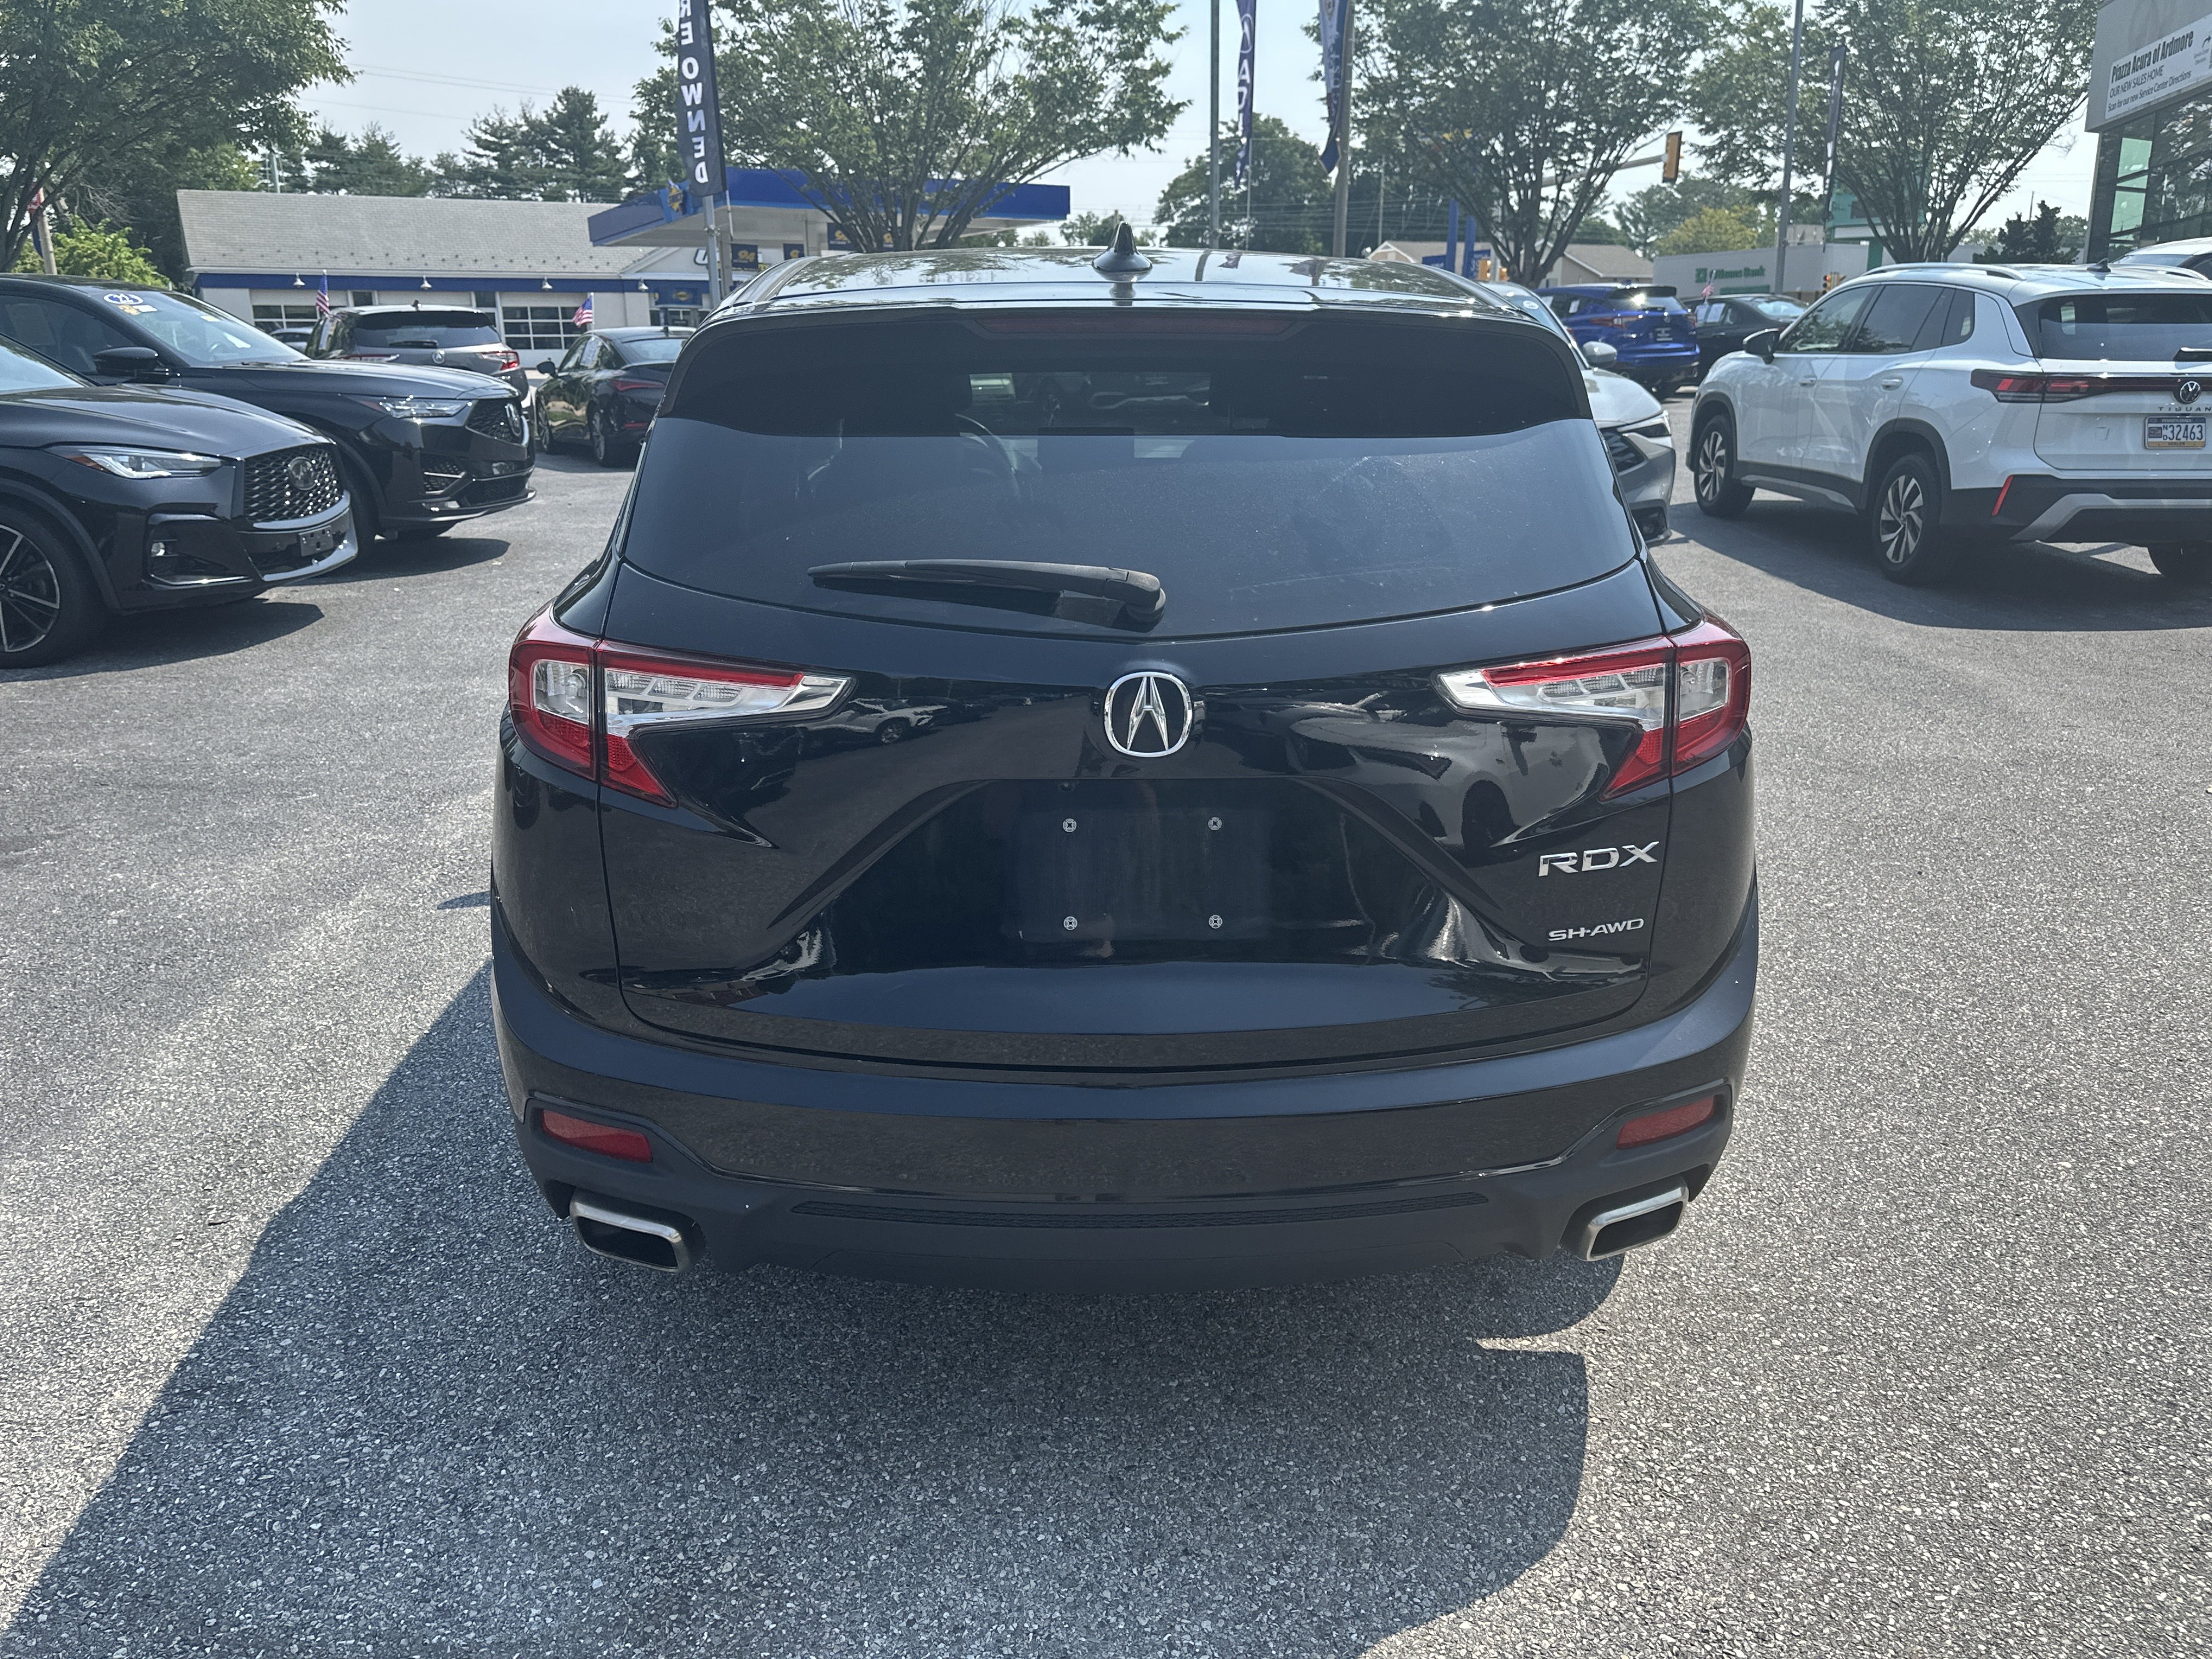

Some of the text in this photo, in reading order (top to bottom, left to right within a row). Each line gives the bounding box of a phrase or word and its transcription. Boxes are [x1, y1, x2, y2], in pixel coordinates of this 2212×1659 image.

[2111, 61, 2131, 83] Piazza
[2131, 51, 2151, 74] Acura
[2152, 43, 2161, 64] of
[2160, 31, 2193, 61] Ardmore
[2108, 103, 2117, 112] Scan
[2129, 94, 2138, 103] new
[2139, 87, 2154, 99] Service
[2154, 80, 2169, 93] Center
[2168, 70, 2192, 87] Directions
[2109, 65, 2164, 98] OUR NEW SALES HOME
[2168, 425, 2203, 441] 32463
[1538, 841, 1660, 877] RDX
[1548, 918, 1645, 941] SH-AWD
